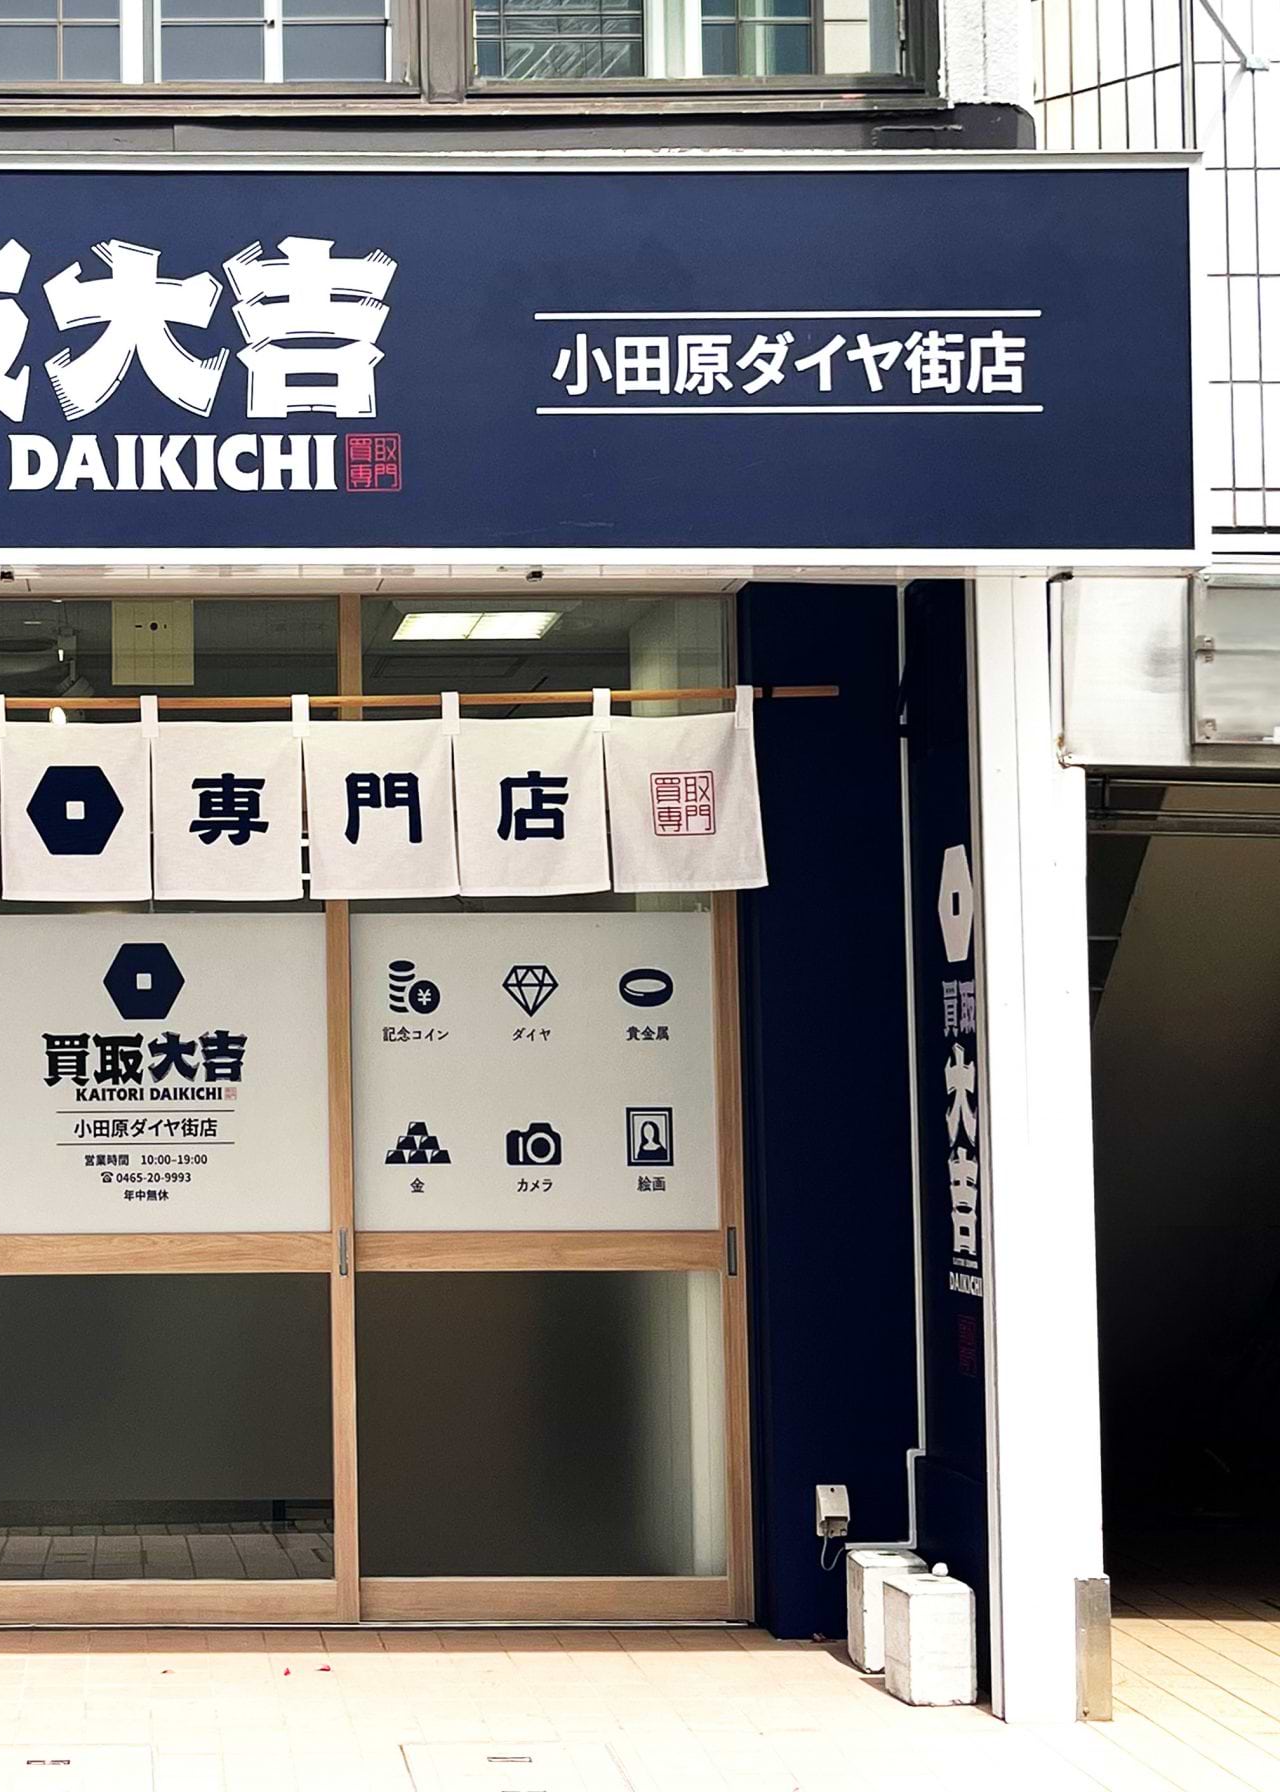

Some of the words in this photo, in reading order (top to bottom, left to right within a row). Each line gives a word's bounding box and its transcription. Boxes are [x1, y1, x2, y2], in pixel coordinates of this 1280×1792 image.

[552, 329, 1026, 396] 小田原ダイヤ街店
[8, 432, 339, 491] DAIKICHI
[381, 1025, 450, 1043] 記念コイン
[512, 1027, 552, 1042] ダイヤ
[625, 1025, 670, 1042] 貴金属
[41, 1029, 249, 1088] 買取大吉
[75, 1087, 145, 1102] KAITORI
[149, 1086, 223, 1101] DAIKICHI
[73, 1117, 218, 1139] 小田原ダイヤ街店
[84, 1153, 130, 1167] 営業時間
[115, 1171, 192, 1184] 0465-20-9993
[409, 1177, 426, 1194] 金
[516, 1177, 553, 1193] カメラ
[636, 1175, 667, 1193] 絵画
[123, 1188, 170, 1203] 年中無休
